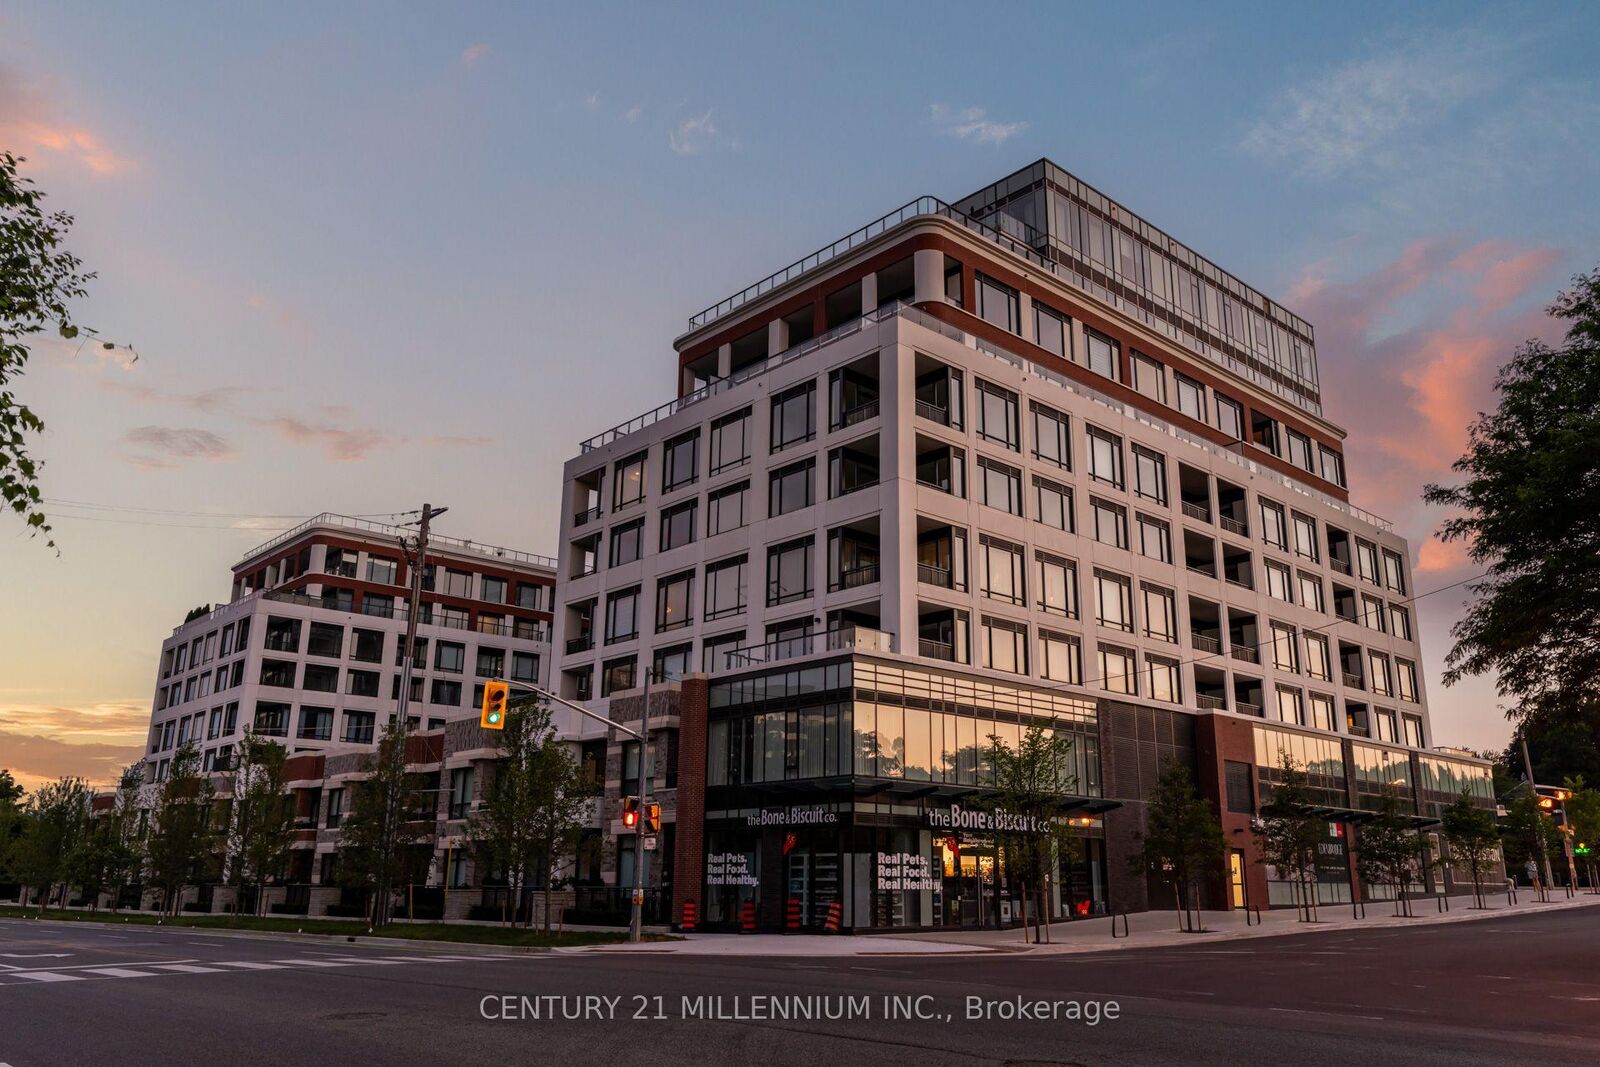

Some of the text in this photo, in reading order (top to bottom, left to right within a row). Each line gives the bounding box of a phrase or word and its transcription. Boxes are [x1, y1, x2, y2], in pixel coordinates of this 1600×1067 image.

[748, 807, 837, 825] the Bone & Biscuit co.
[929, 809, 950, 827] the
[951, 804, 986, 829] Bone
[987, 816, 994, 829] &
[708, 852, 748, 863] Real Pets.
[878, 852, 928, 865] Real Pets.
[708, 864, 724, 874] Real
[878, 865, 900, 877] Real
[707, 875, 759, 887] Real Healthy.
[878, 878, 943, 893] Real Healthy.
